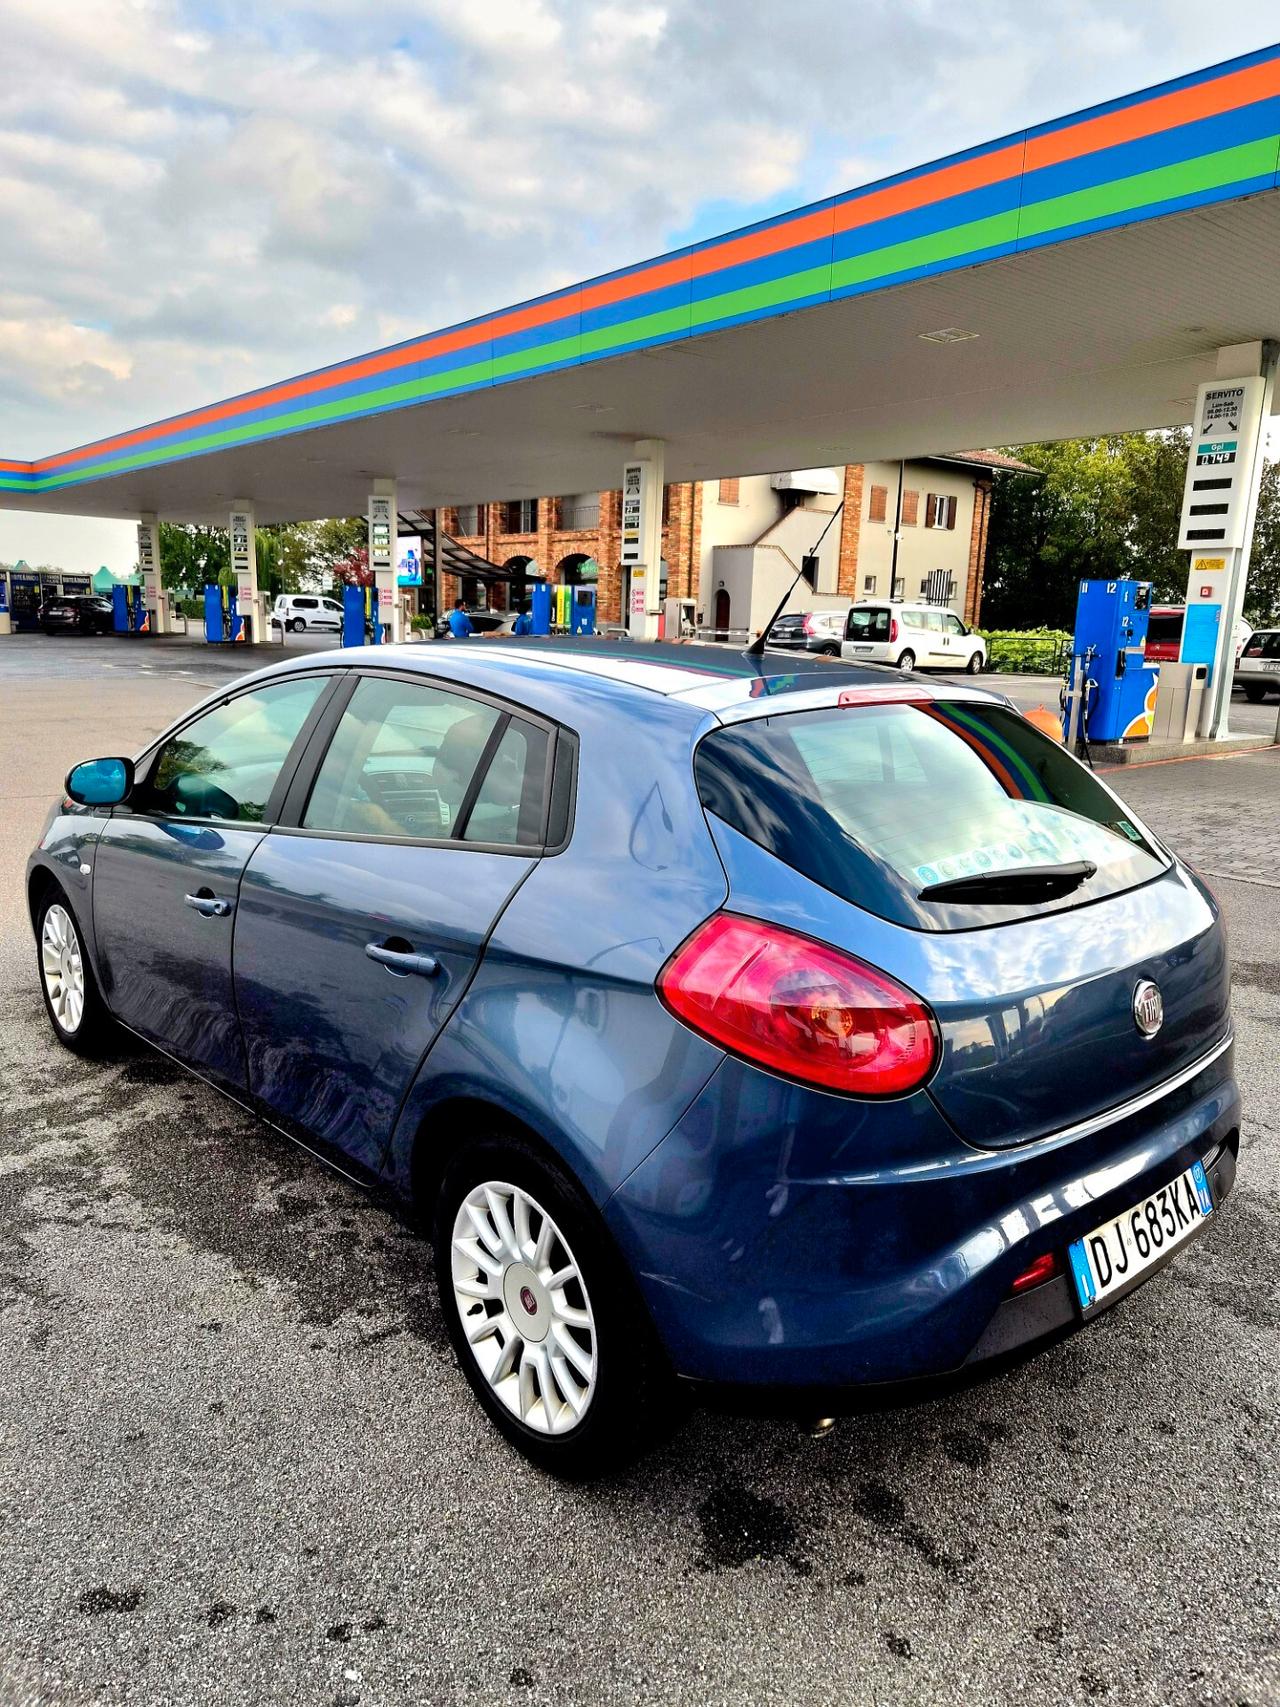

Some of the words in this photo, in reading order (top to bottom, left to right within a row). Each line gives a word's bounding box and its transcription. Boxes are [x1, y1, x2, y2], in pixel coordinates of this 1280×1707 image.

[1206, 389, 1243, 400] SERVITO
[1211, 443, 1224, 451] Gpl
[1107, 582, 1117, 593] 12
[1089, 1222, 1128, 1288] DJ
[1131, 1174, 1200, 1258] 683KA
